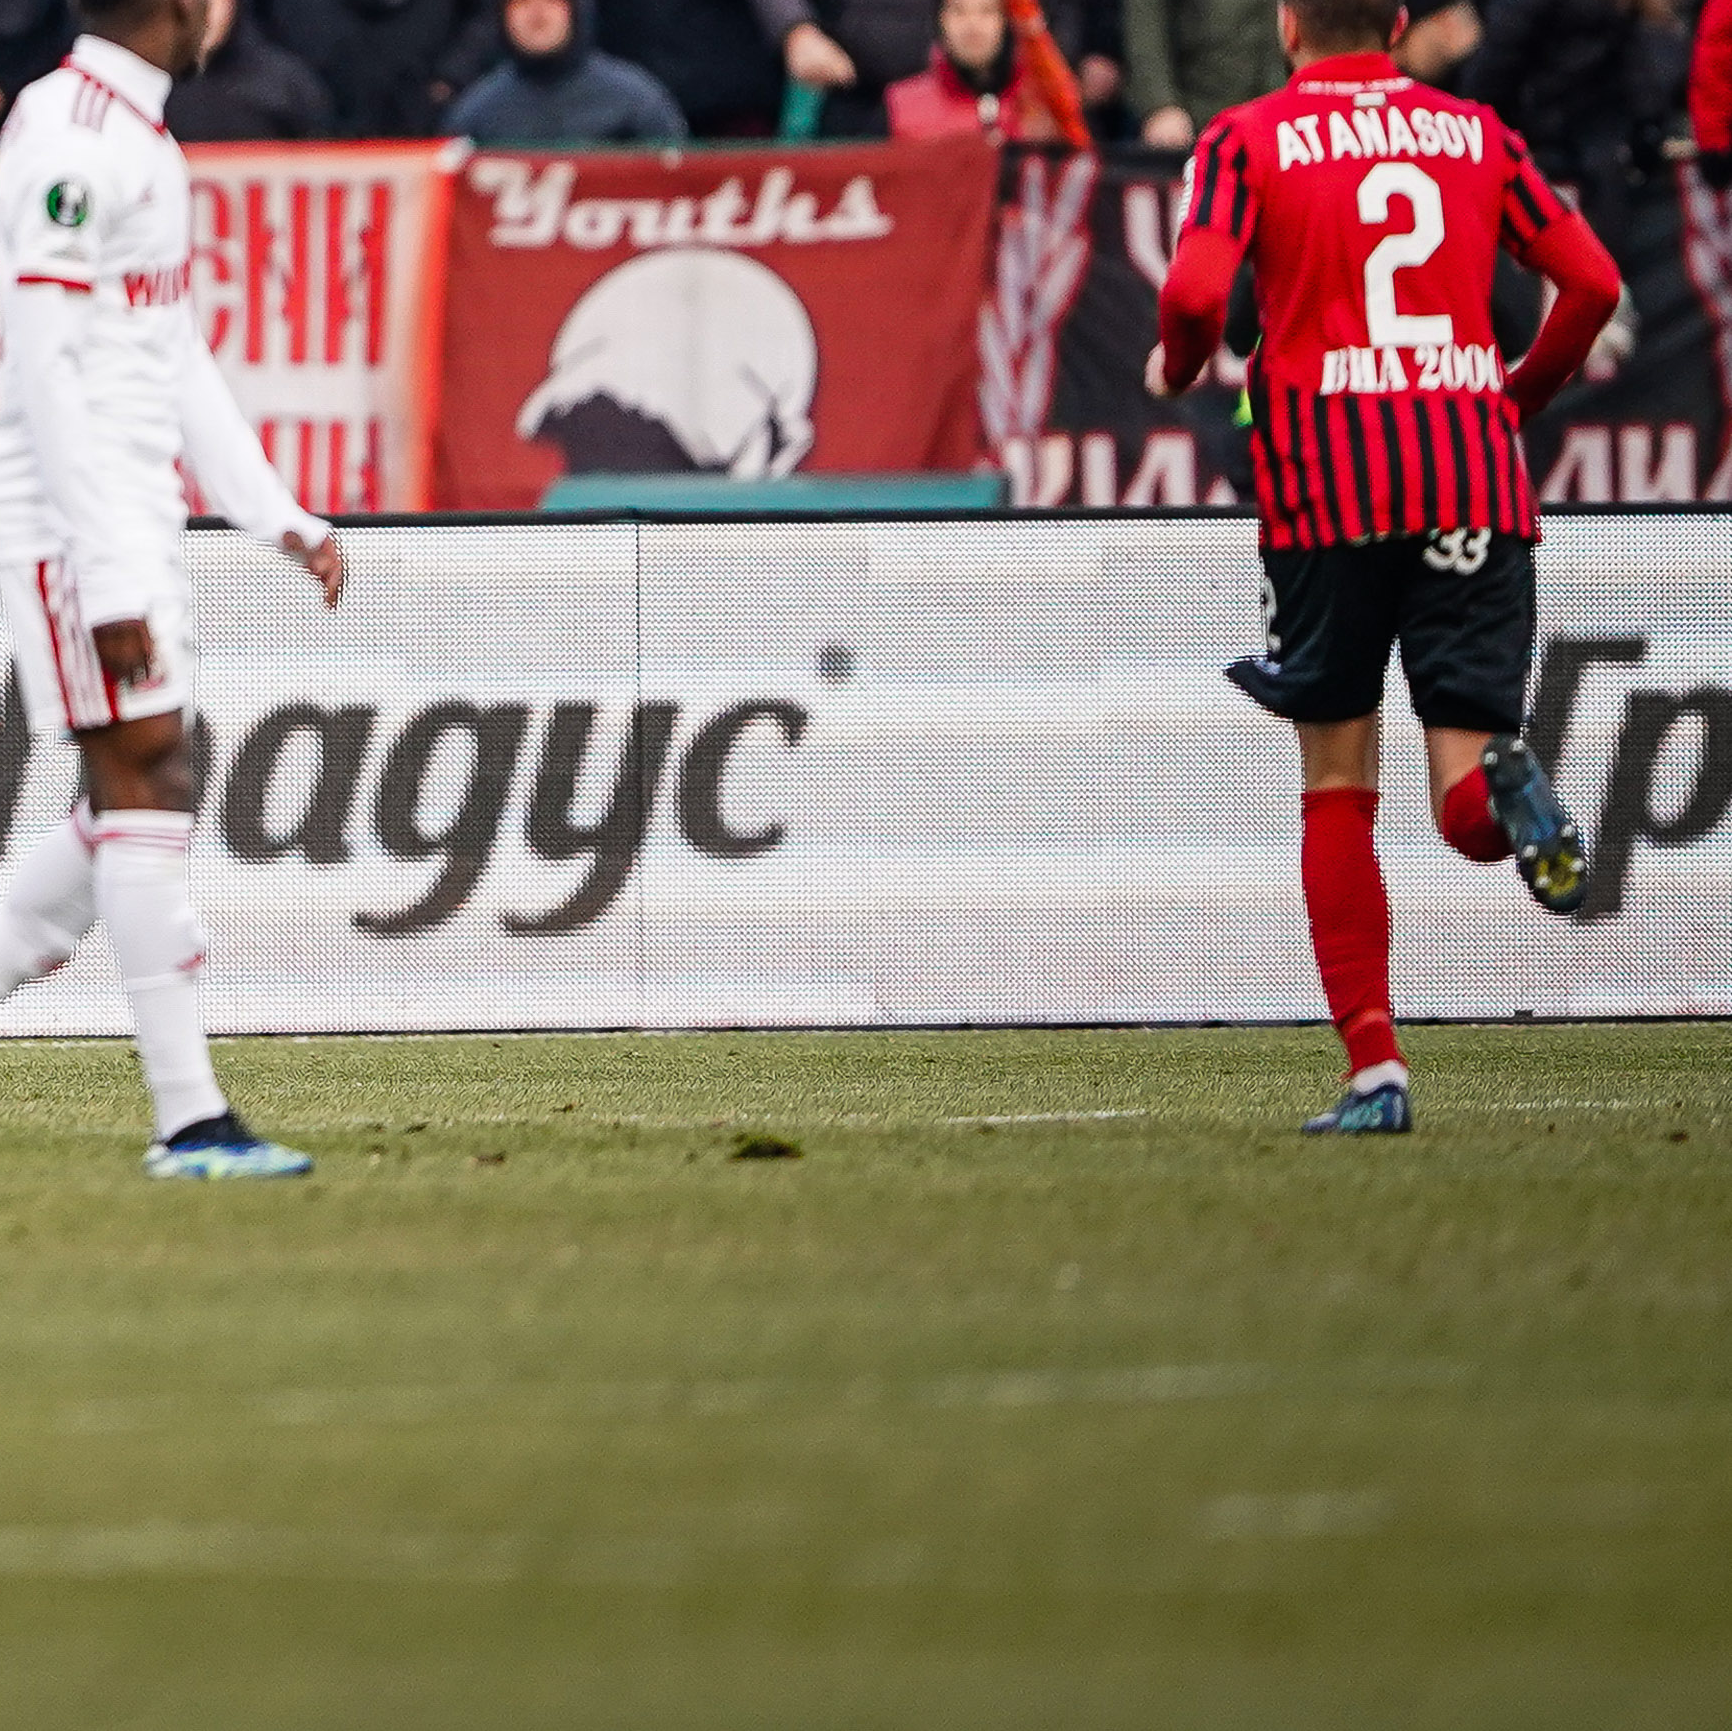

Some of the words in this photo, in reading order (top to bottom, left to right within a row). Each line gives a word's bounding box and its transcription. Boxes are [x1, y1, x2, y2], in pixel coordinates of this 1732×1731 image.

[1276, 105, 1483, 172] ATANASOV
[468, 158, 895, 249] Youths
[1357, 161, 1453, 348] 2
